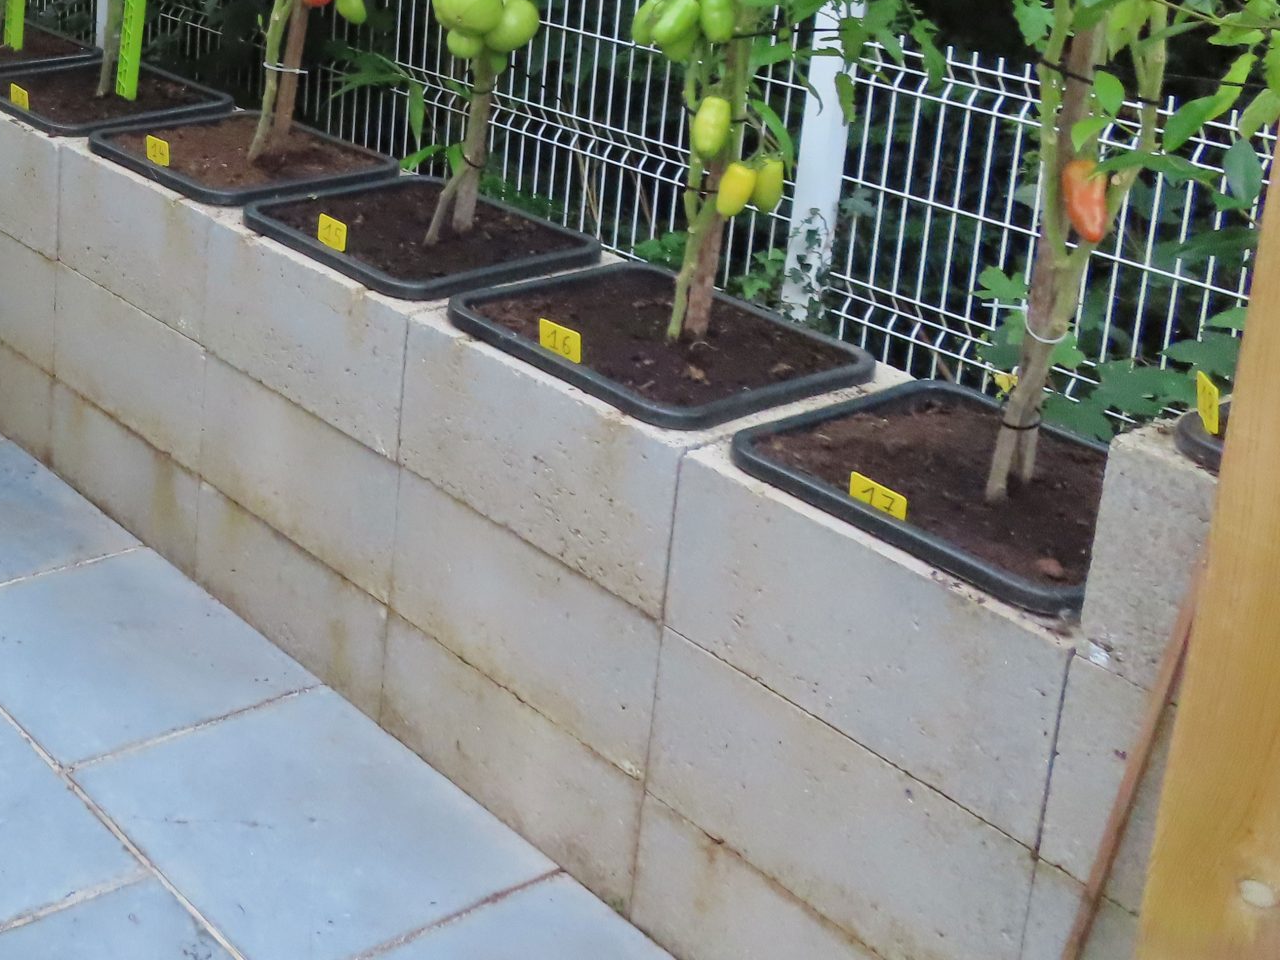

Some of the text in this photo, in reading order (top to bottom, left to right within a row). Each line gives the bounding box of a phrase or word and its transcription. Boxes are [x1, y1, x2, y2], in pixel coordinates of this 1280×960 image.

[322, 223, 342, 247] 15
[547, 329, 571, 356] 16
[861, 486, 896, 513] 17
